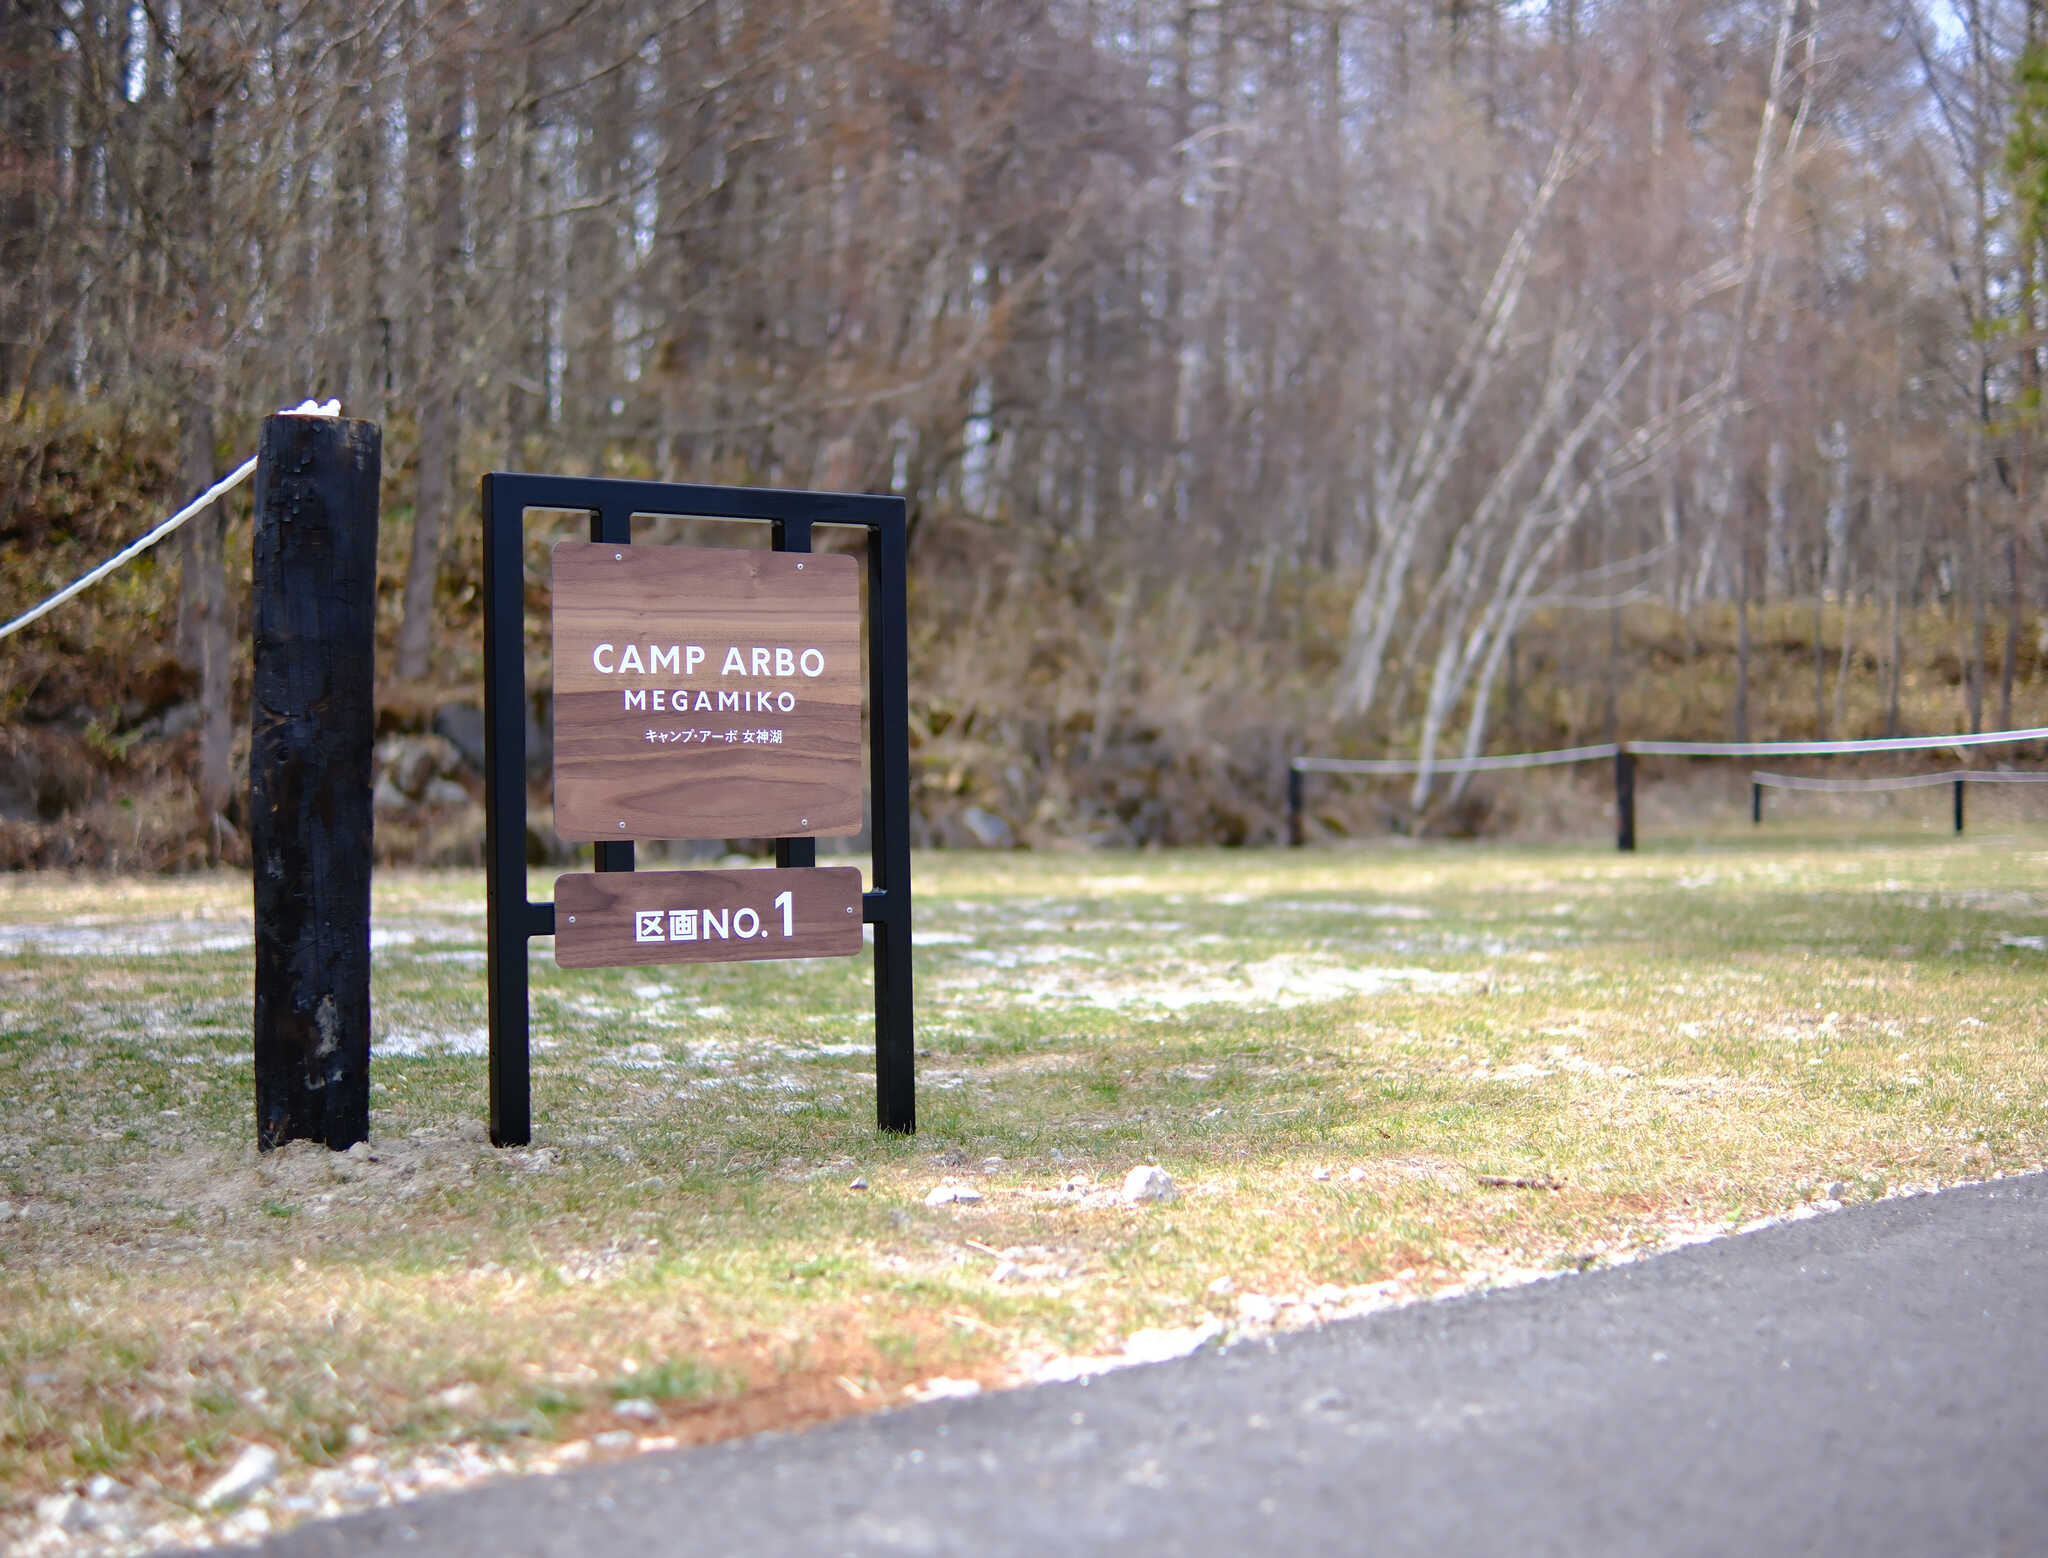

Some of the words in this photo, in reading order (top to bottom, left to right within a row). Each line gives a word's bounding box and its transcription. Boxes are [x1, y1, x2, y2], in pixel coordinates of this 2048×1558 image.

[593, 643, 706, 675] CAMP
[721, 646, 825, 678] ARBO
[624, 689, 796, 712] MEGAMIKO
[742, 729, 783, 744] 女神湖
